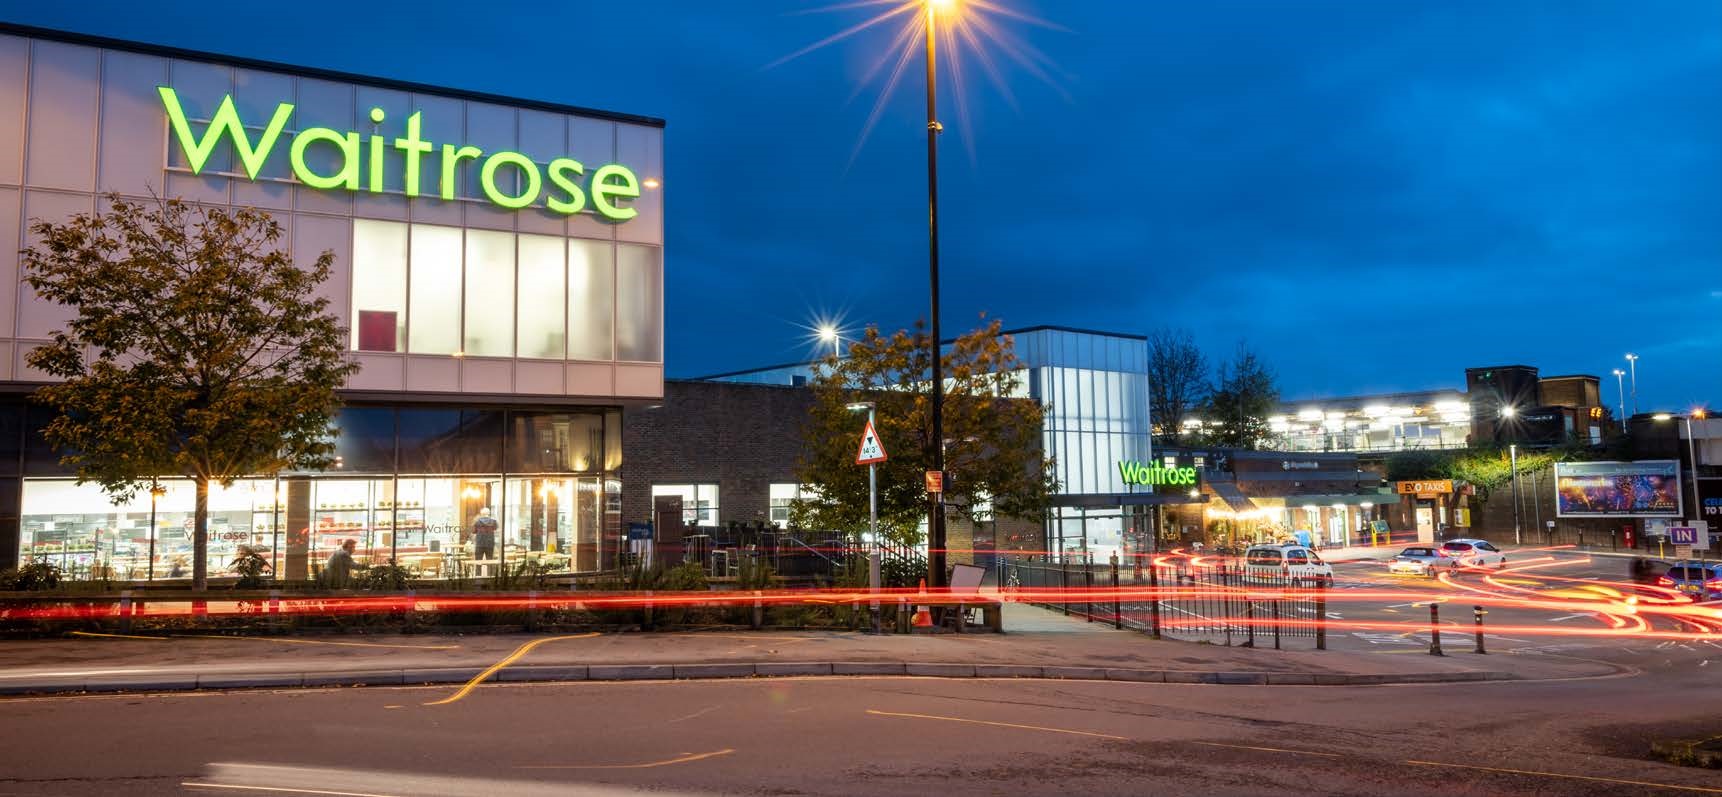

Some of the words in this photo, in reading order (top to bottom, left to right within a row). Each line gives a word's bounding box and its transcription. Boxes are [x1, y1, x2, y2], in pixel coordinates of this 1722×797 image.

[157, 86, 641, 220] Waitrose
[1118, 459, 1196, 485] Waitrose
[1405, 483, 1422, 492] EVO
[1423, 482, 1445, 492] TAXIS
[1704, 506, 1717, 515] TO
[184, 529, 248, 541] Witrose
[1676, 530, 1692, 542] IN
